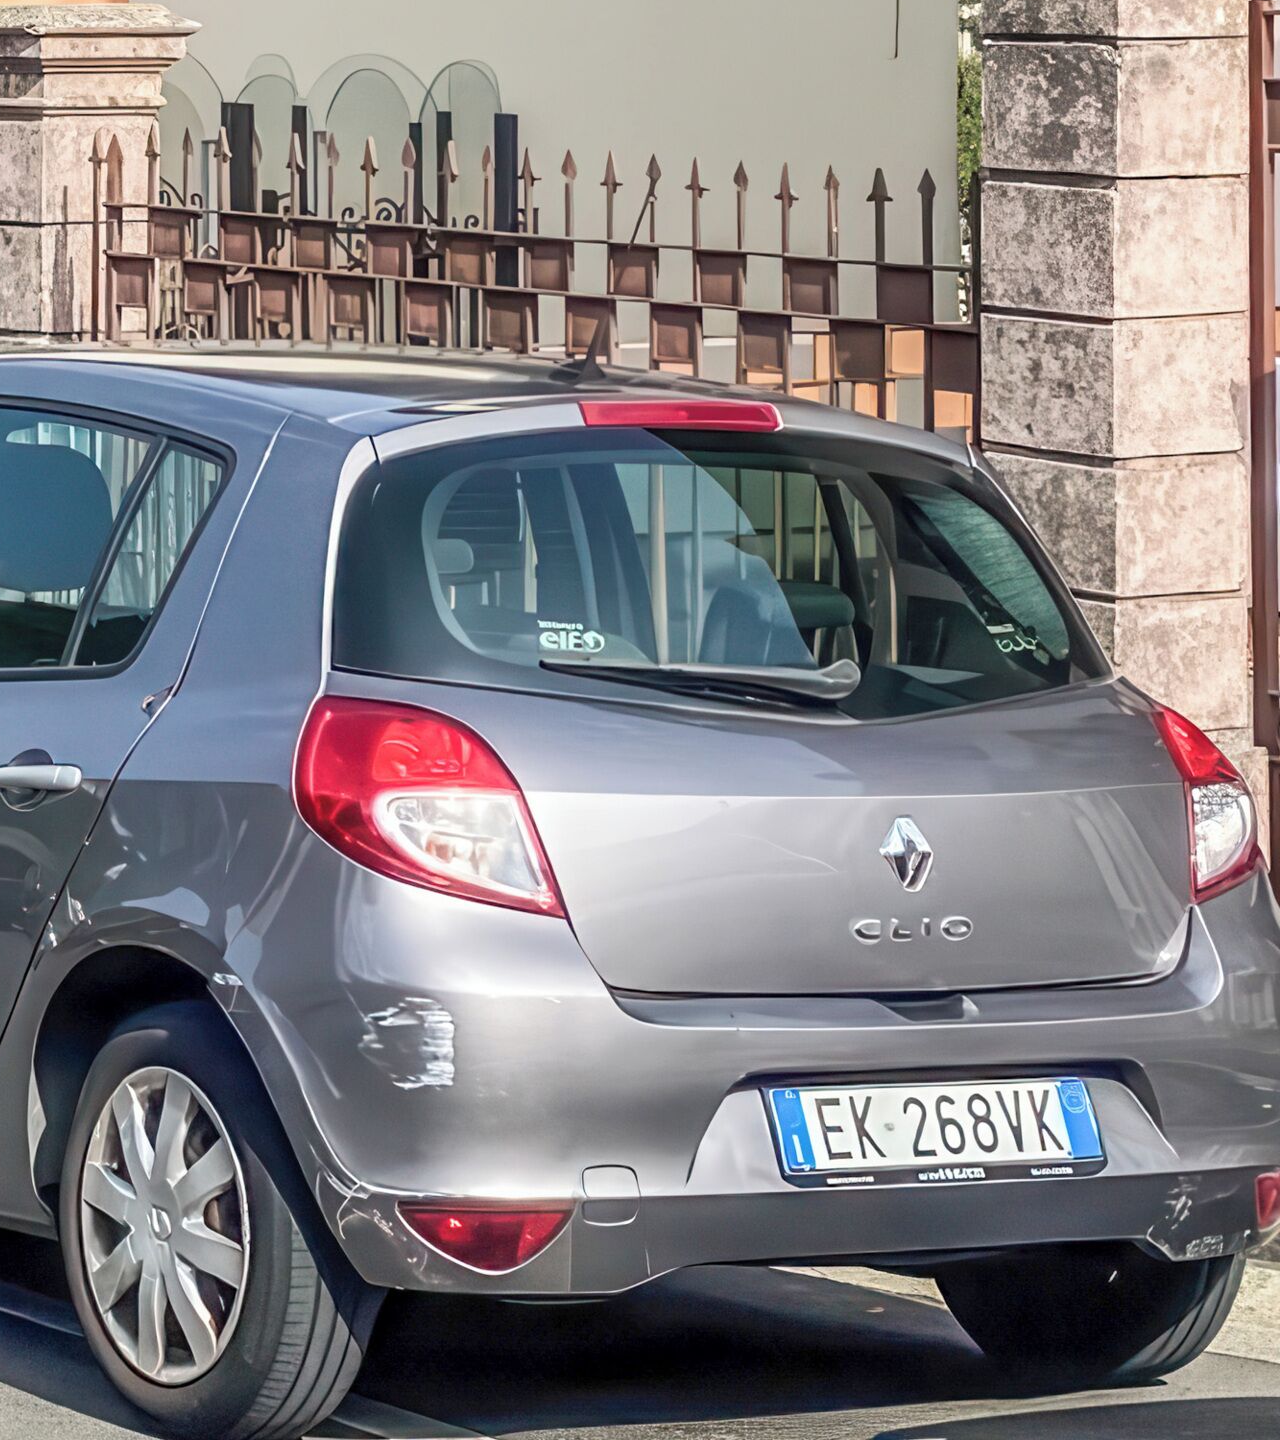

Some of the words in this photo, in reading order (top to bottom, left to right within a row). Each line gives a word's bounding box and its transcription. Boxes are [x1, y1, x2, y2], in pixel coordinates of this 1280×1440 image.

[853, 916, 974, 945] CLIO
[814, 1096, 887, 1160] EK
[903, 1090, 1065, 1158] 268VK
